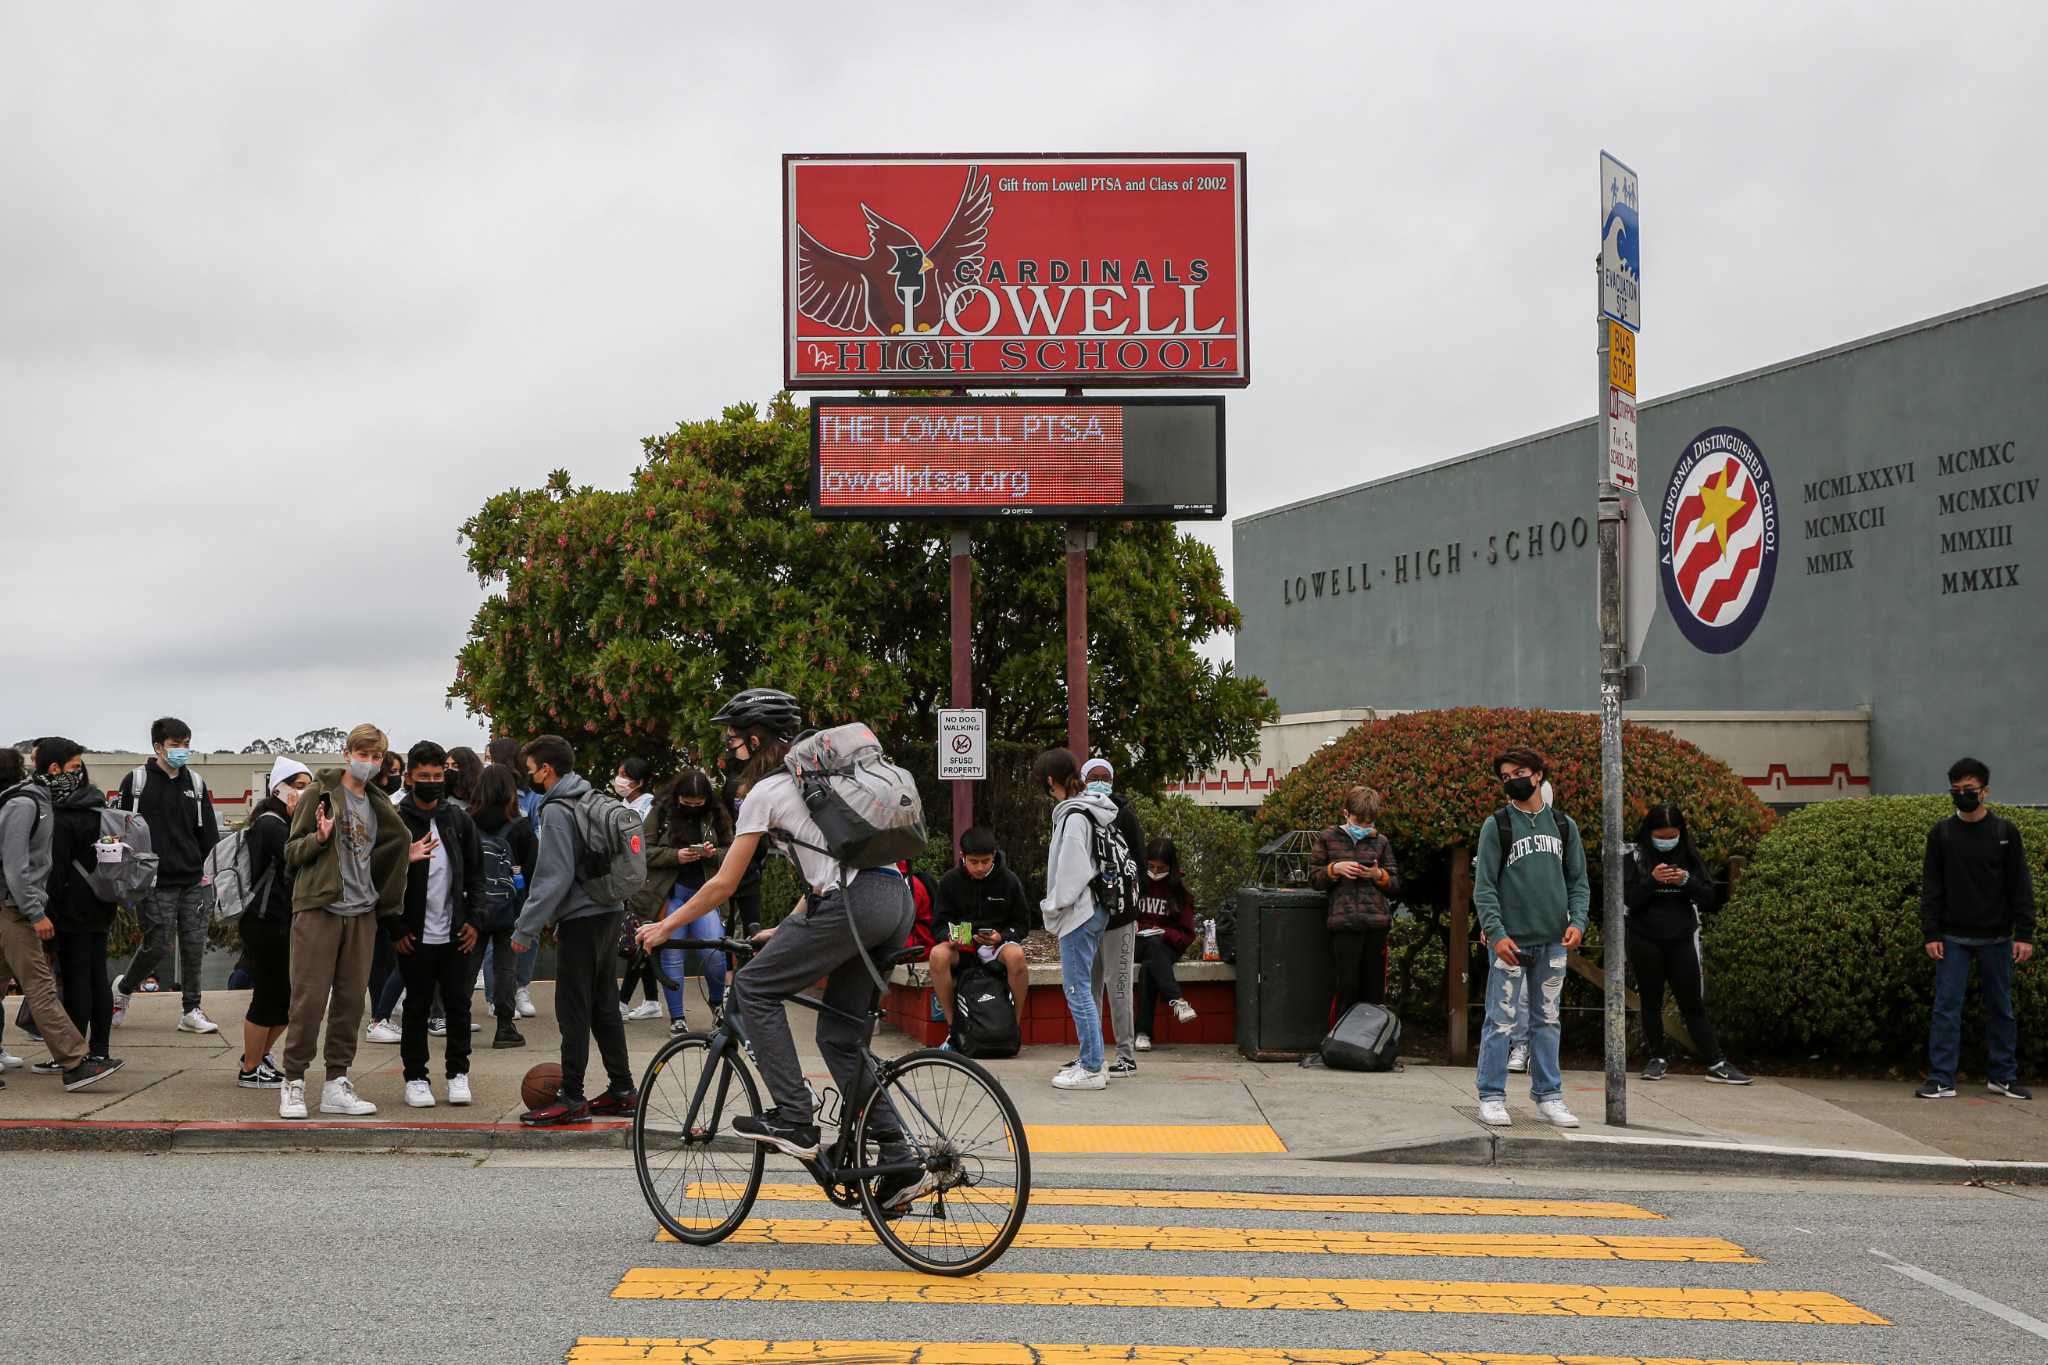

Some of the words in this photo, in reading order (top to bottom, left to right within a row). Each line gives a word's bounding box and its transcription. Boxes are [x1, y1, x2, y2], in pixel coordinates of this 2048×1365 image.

[998, 177, 1019, 191] Gift
[1022, 177, 1049, 191] from
[1052, 177, 1088, 191] Lowell
[1091, 177, 1121, 191] PTSA
[1125, 177, 1146, 191] and
[1149, 177, 1178, 191] Class
[1182, 176, 1194, 191] of
[1197, 177, 1227, 190] 2002
[955, 259, 1209, 283] CARDINALS
[898, 284, 1226, 337] LOWELL
[836, 341, 975, 371] HIGH
[1000, 340, 1228, 370] SCHOOL
[1615, 328, 1630, 358] BUS
[1613, 355, 1633, 386] STOP
[820, 416, 873, 444] THE
[884, 415, 1011, 443] LOWELL
[1023, 415, 1104, 442] PTSA
[1694, 434, 1763, 480] DISTINGUISHED
[1937, 440, 2016, 477] MCMXC
[820, 465, 1029, 496] lowellptsa.org
[1803, 461, 1915, 504] MCMLXXXVI
[1661, 455, 1694, 545] CALIFORNIA
[1937, 478, 2040, 515] MCMXCIV
[1759, 480, 1775, 554] SCHOOL
[1804, 506, 1886, 540] MCMXCII
[1940, 524, 2014, 554] MMXIII
[1284, 562, 1371, 605] LOWELL
[1395, 542, 1461, 584] HIGH
[1661, 552, 1671, 565] A
[1805, 550, 1855, 575] MMIX
[1941, 564, 2021, 595] MMXIX
[943, 766, 981, 774] PROPERTY
[1534, 834, 1563, 864] SUNWE
